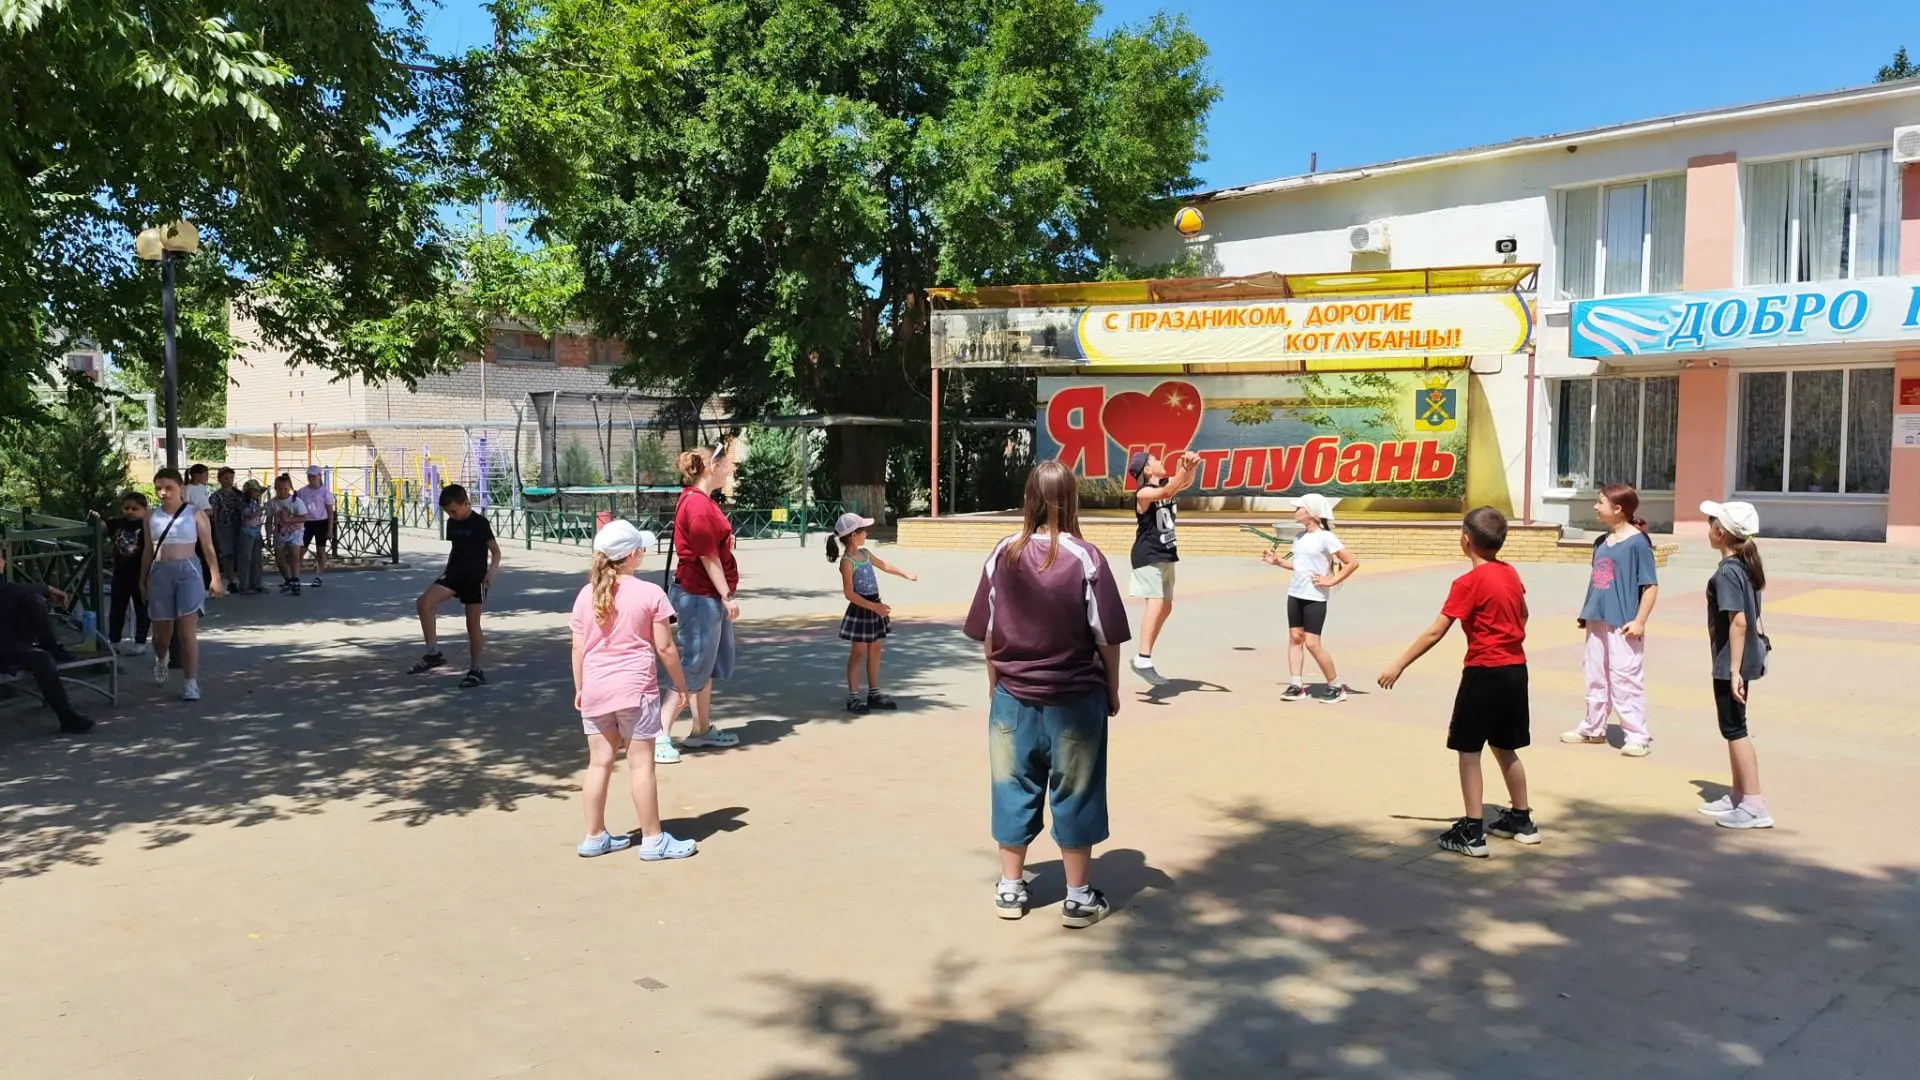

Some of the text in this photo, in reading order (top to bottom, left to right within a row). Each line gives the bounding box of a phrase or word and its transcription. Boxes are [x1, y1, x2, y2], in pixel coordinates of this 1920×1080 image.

[1104, 302, 1412, 330] С ПРАЗДНИКОМ, ДОРОГИЕ
[1666, 289, 1868, 347] ДОБРО
[1286, 328, 1462, 351] КОТЛУБАНЦЫ!
[1047, 385, 1107, 478] Я
